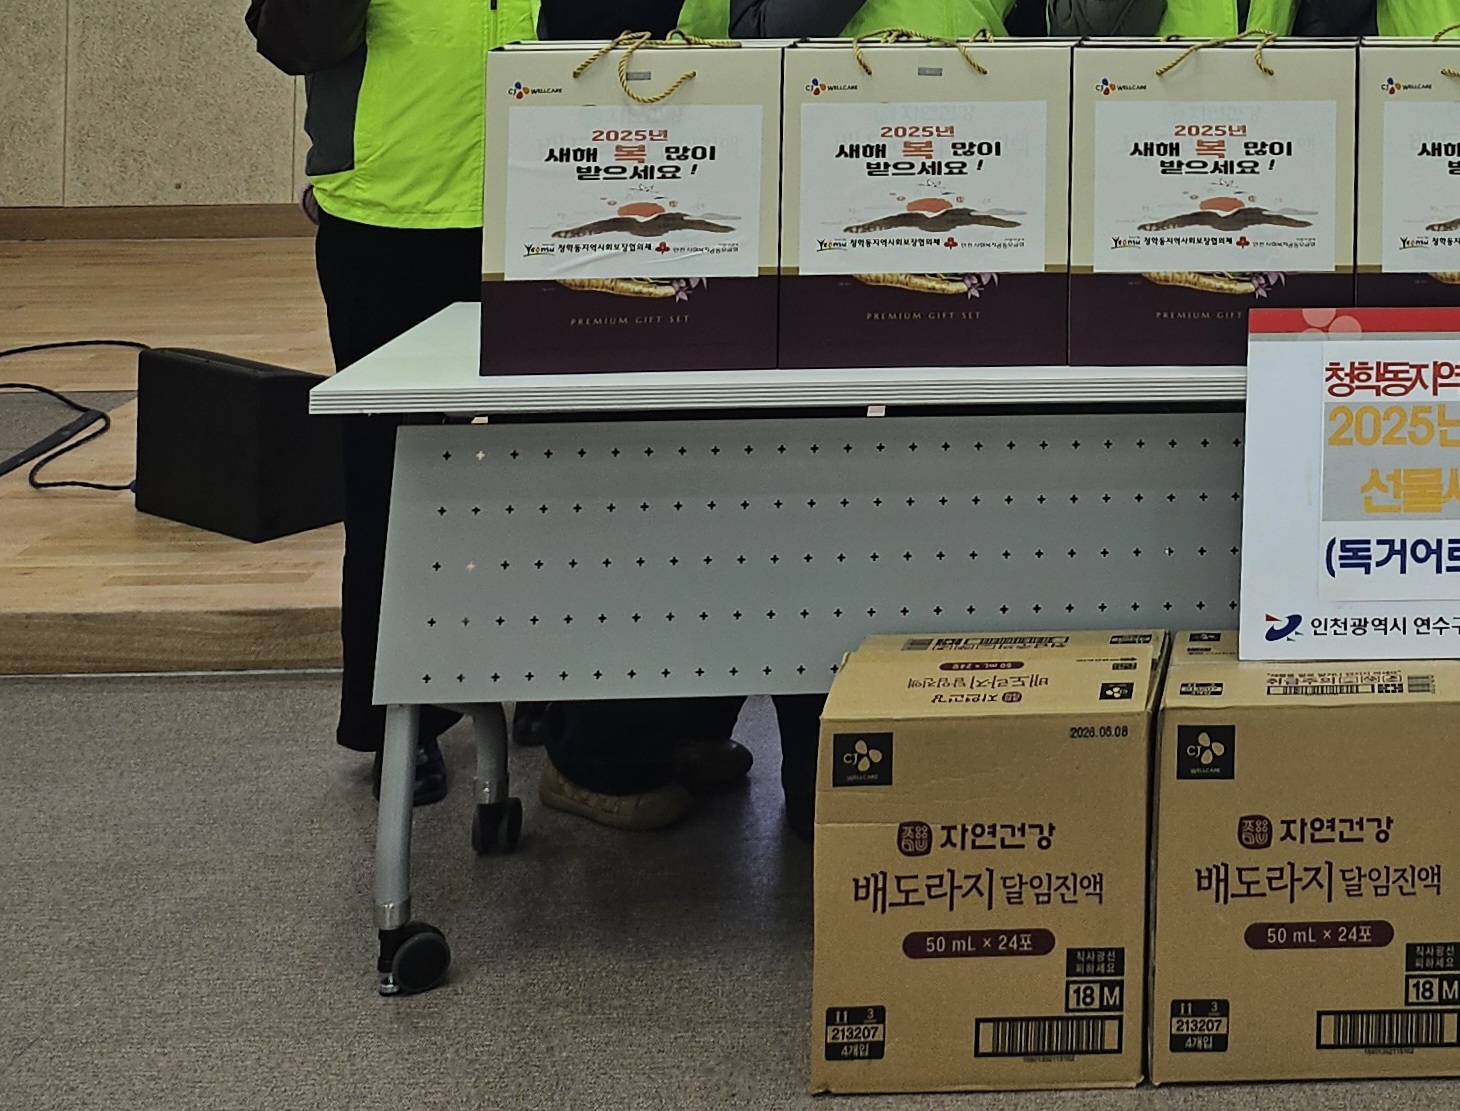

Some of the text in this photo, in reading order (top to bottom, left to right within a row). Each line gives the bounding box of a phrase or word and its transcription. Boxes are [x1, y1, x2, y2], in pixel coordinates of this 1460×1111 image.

[592, 129, 668, 142] 2025년
[881, 126, 954, 138] 2025년
[1174, 125, 1246, 137] 2025년
[544, 145, 716, 162] 새해 복 많이
[836, 141, 1001, 159] 새해 복 많이
[1130, 140, 1292, 158] 새해 복 많이
[571, 317, 628, 325] PREMIUM
[635, 315, 661, 323] GIFT
[866, 312, 922, 320] PREMIUM
[962, 311, 981, 319] SET
[1156, 311, 1243, 319] PREMIUM GIFT
[1310, 616, 1407, 637] 인천광역시
[1187, 745, 1201, 756] CJ
[843, 754, 858, 764] CJ
[941, 822, 1055, 851] 자연건강
[1280, 817, 1394, 844] 자연건강
[1196, 861, 1441, 905] 배도라지 달임진액
[853, 868, 1104, 914] 배도라지 달임진액
[1267, 927, 1372, 942] 50 mL 24포
[926, 935, 1033, 952] 50 mL 24포
[1176, 1019, 1222, 1032] 213207
[832, 1026, 878, 1040] 213207
